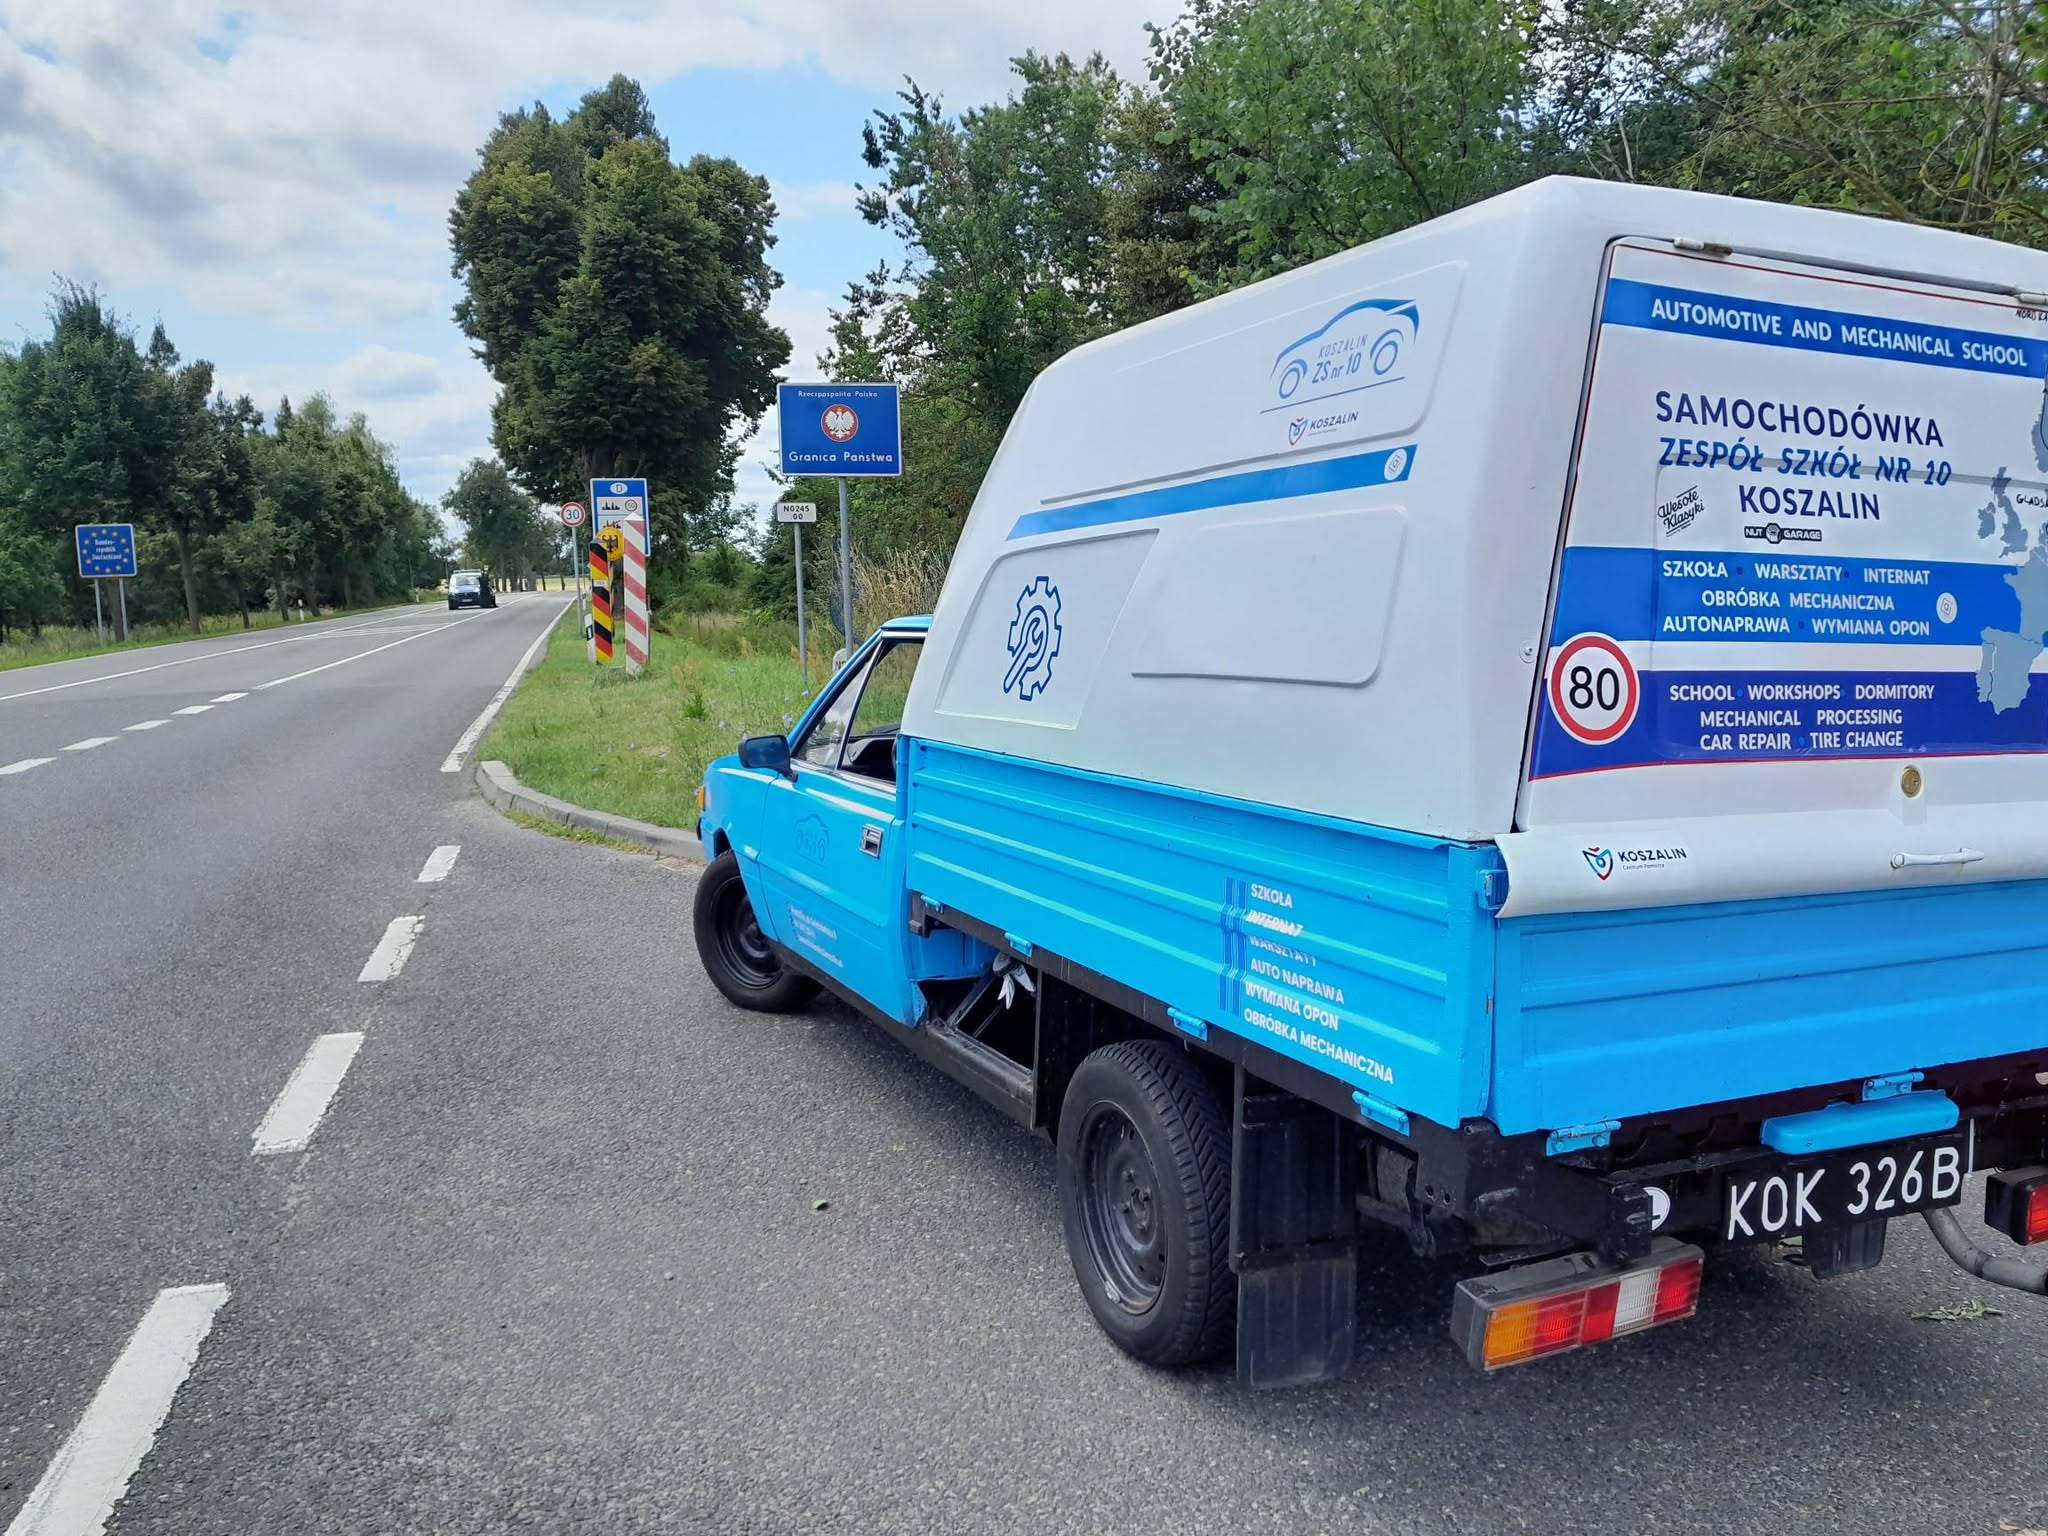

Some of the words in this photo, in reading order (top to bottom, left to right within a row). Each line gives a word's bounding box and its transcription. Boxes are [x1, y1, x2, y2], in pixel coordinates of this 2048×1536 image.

[1651, 298, 1782, 336] AUTOMOTIVE
[1792, 320, 1832, 341] AND
[1842, 325, 1954, 358] MECHANICAL
[1962, 342, 2027, 367] SCHOOL
[1319, 334, 1367, 358] KOSZALIN
[1312, 360, 1331, 384] ZS
[1331, 365, 1344, 379] nr
[1346, 352, 1361, 375] 10
[1310, 411, 1359, 430] KOSZALIN
[1656, 391, 1943, 447] SAMOCHODÓWKA
[788, 451, 837, 462] Granica
[843, 451, 893, 462] Państwa
[1659, 436, 1764, 472] ZESPÓŁ
[1777, 446, 1862, 480] SZKÓŁ
[1875, 456, 1911, 483] NR
[1924, 460, 1952, 486] 10
[566, 509, 580, 520] 30
[1657, 490, 1699, 518] Wesołe
[1663, 500, 1704, 529] Klasyki
[1739, 485, 1880, 521] KOSZALIN
[1745, 527, 1763, 538] NUT
[1783, 530, 1821, 541] GARAGE
[1663, 560, 1728, 578] SZKOŁA
[1755, 563, 1843, 582] WARSZTATY
[1864, 567, 1930, 585] INTERNAT
[1701, 587, 1780, 608] OBRÓBKA
[1789, 592, 1894, 611] MECHANICZNA
[1663, 616, 1790, 633] AUTONAPRAWA
[1811, 618, 1885, 635] WYMIANA
[1889, 620, 1930, 636] OPON
[1569, 665, 1620, 711] 80
[1669, 684, 1735, 701] SCHOOL
[1748, 684, 1841, 700] WORKSHOPS
[1855, 684, 1935, 701] DORMITORY
[1700, 710, 1801, 727] MECHANICAL
[1817, 709, 1903, 726] PROCESSING
[1700, 732, 1733, 750] CAR
[1739, 732, 1791, 750] REPAIR
[1809, 731, 1841, 749] TIRE
[1845, 730, 1903, 748] CHANGE
[1618, 848, 1687, 862] KOSZALIN
[1251, 883, 1293, 908] SZKOŁA
[1251, 958, 1280, 980] AUTO
[1282, 970, 1344, 1004] NAPRAWA
[1245, 981, 1300, 1016] WYMIANA
[1303, 1004, 1339, 1031] OPON
[1244, 1008, 1297, 1043] OBRÓBKA
[1300, 1030, 1393, 1084] MECHANICZNA
[1728, 1168, 1825, 1241] KOK
[1847, 1146, 1960, 1216] 326B
